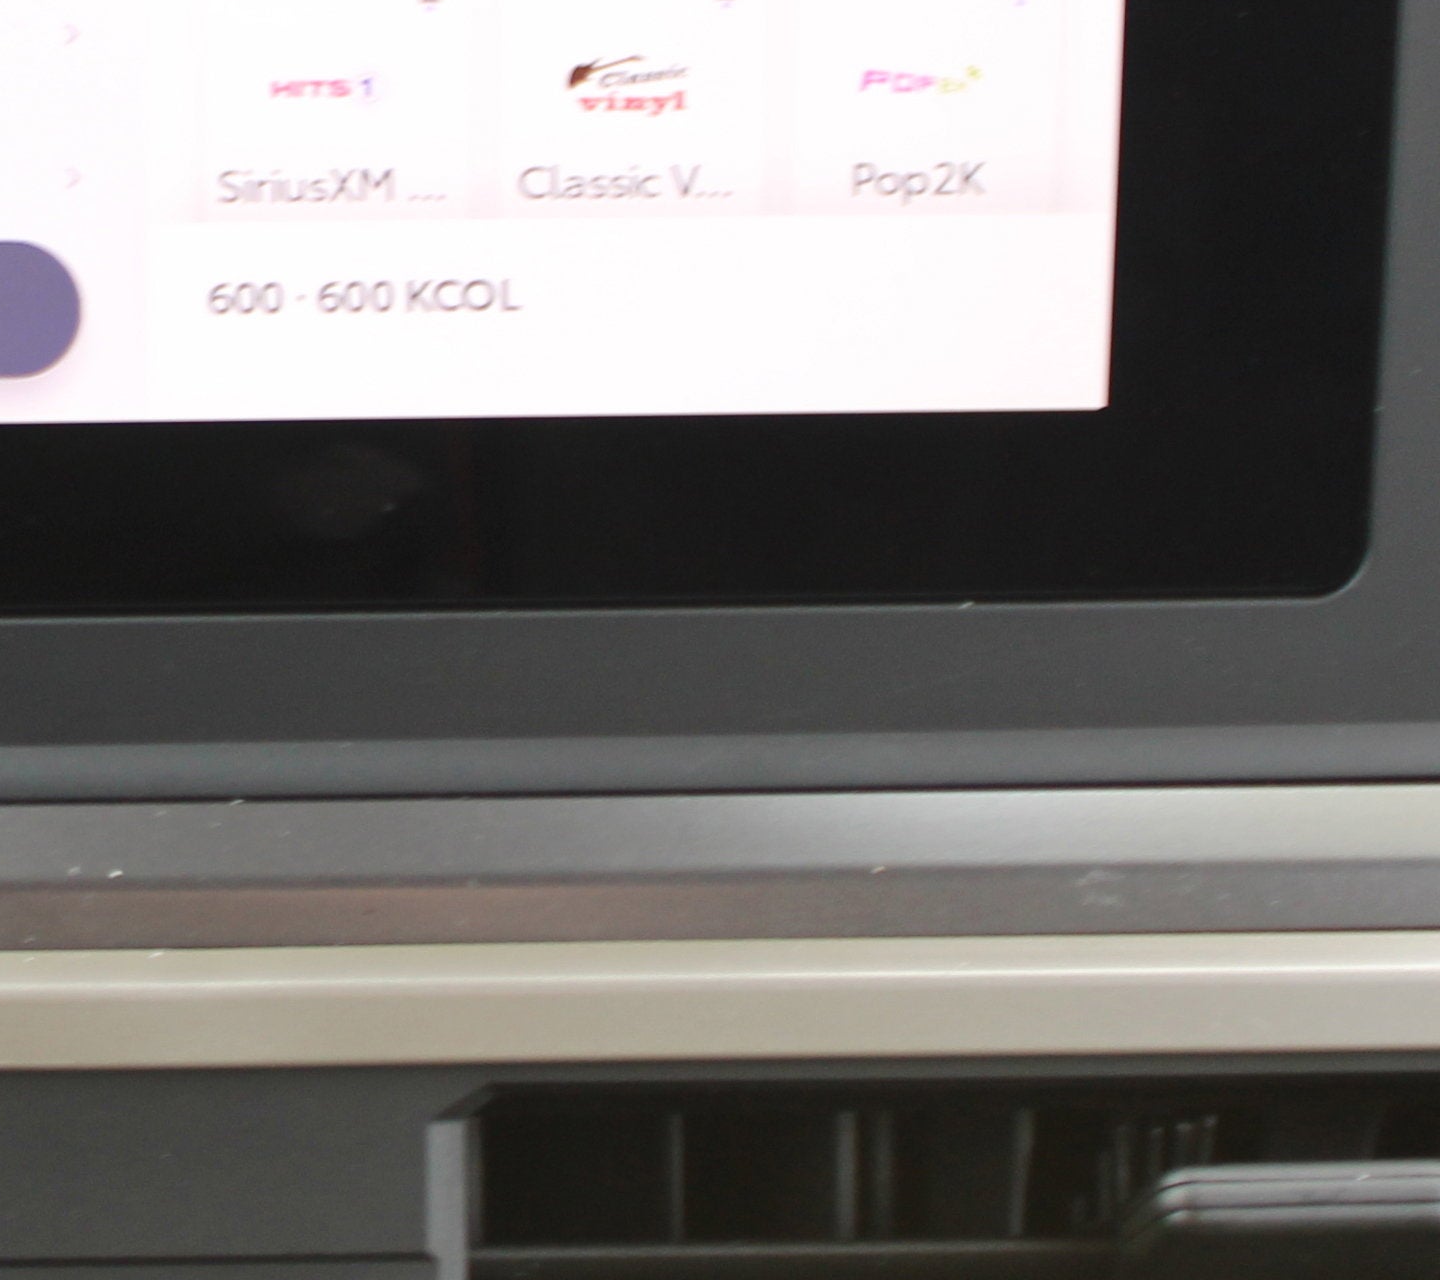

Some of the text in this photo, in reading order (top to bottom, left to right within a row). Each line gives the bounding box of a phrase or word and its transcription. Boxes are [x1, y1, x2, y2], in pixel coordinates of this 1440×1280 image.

[270, 79, 352, 98] HITS
[578, 90, 687, 116] vinyl
[218, 168, 394, 204] SiriusXM
[517, 164, 665, 201] Classic
[852, 162, 984, 204] Pop2K
[208, 279, 521, 315] 600 600 KCOL
